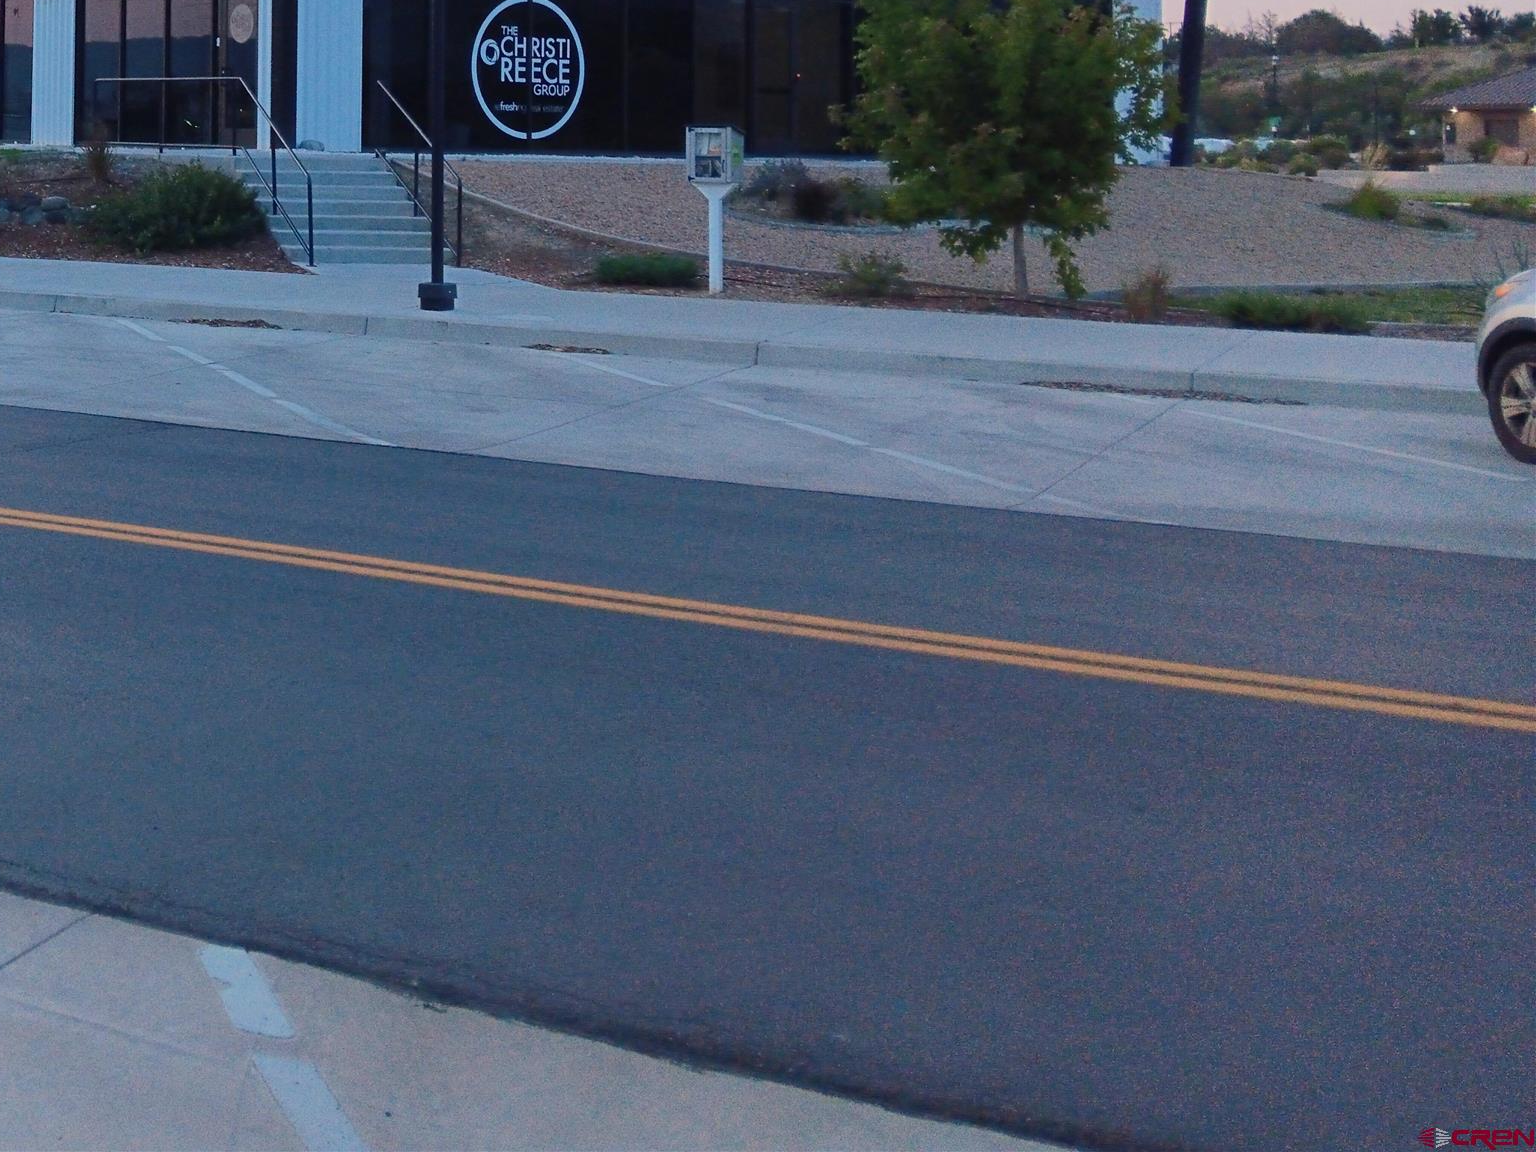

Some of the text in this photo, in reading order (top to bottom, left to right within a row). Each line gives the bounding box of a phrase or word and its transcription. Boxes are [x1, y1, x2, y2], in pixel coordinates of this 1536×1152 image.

[501, 25, 519, 36] THE
[500, 35, 571, 59] CHRISTI
[500, 56, 570, 84] REECE
[533, 83, 571, 97] GROUP
